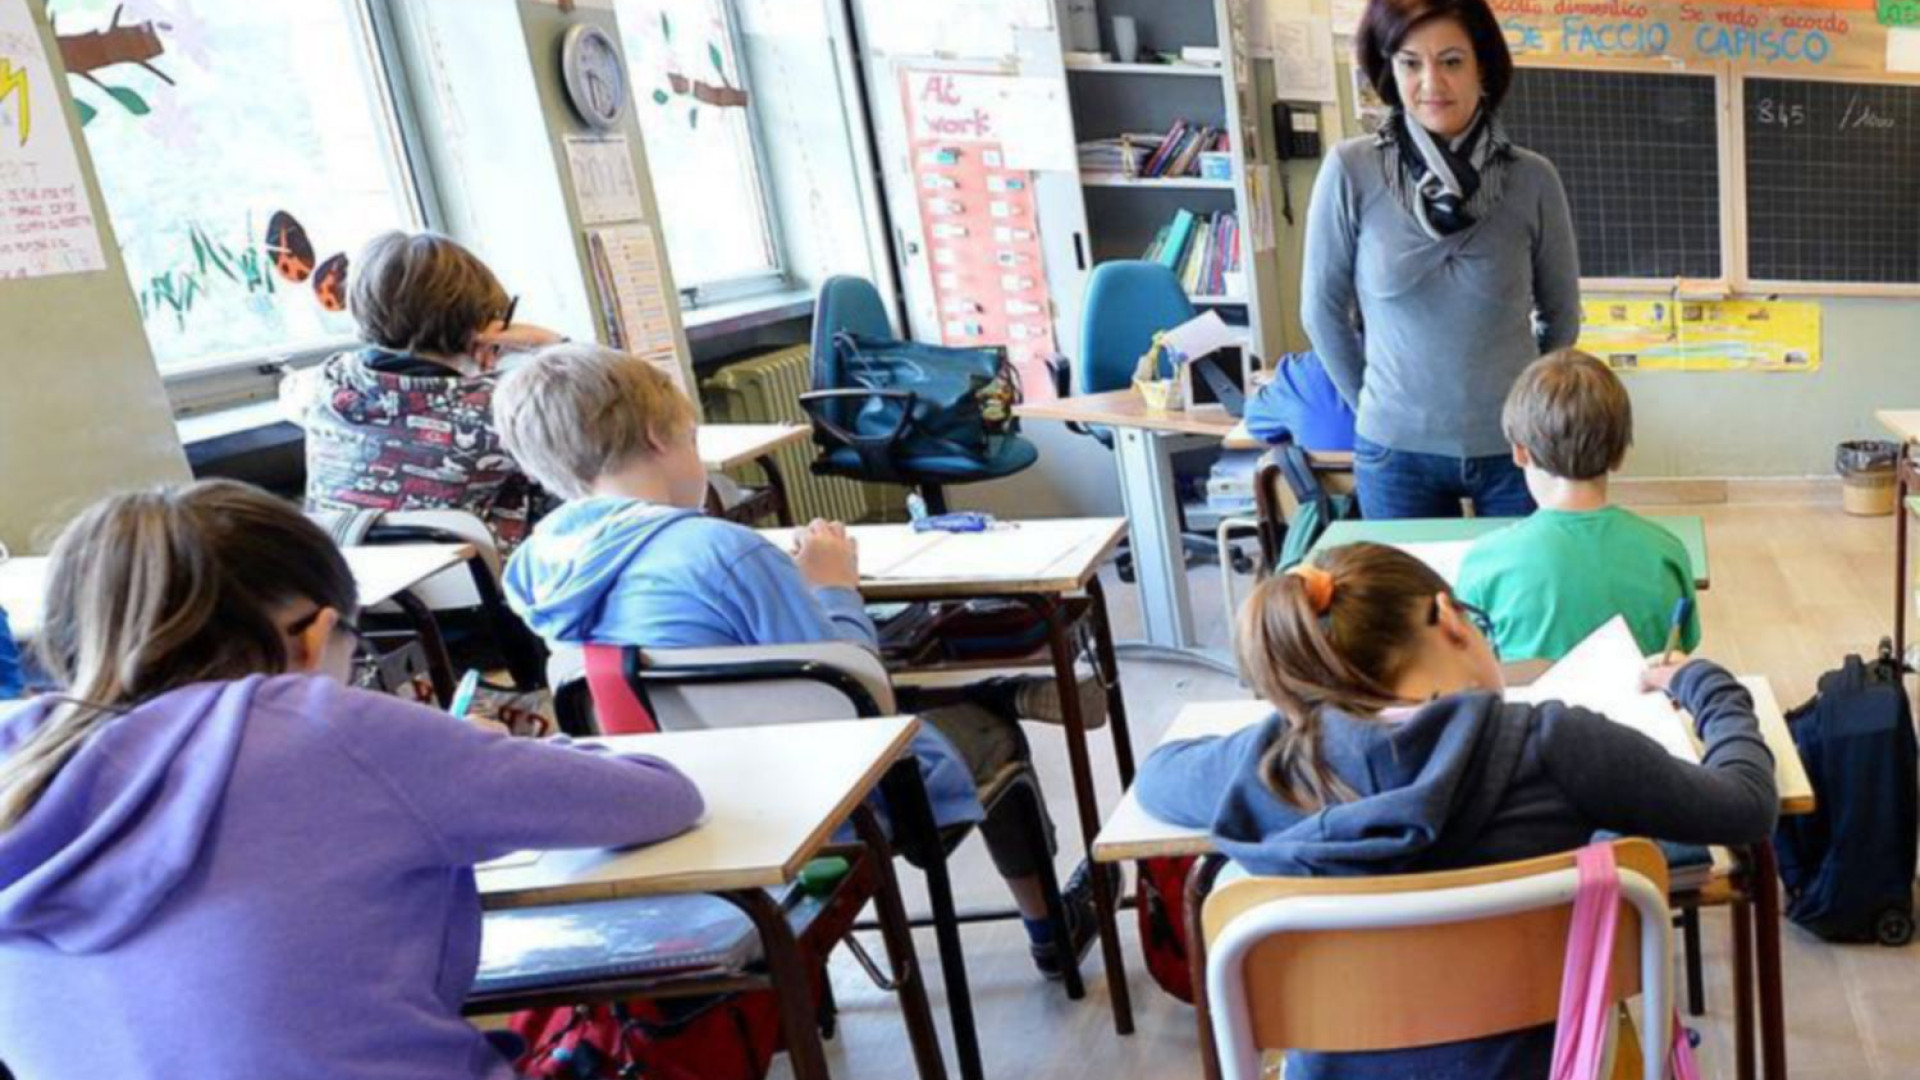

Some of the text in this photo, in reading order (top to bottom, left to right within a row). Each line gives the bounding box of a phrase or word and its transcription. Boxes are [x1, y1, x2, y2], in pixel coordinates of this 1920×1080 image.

[1561, 16, 1671, 52] FACCIO
[1695, 24, 1831, 64] CAPISCO
[920, 75, 962, 106] At
[922, 107, 991, 137] work
